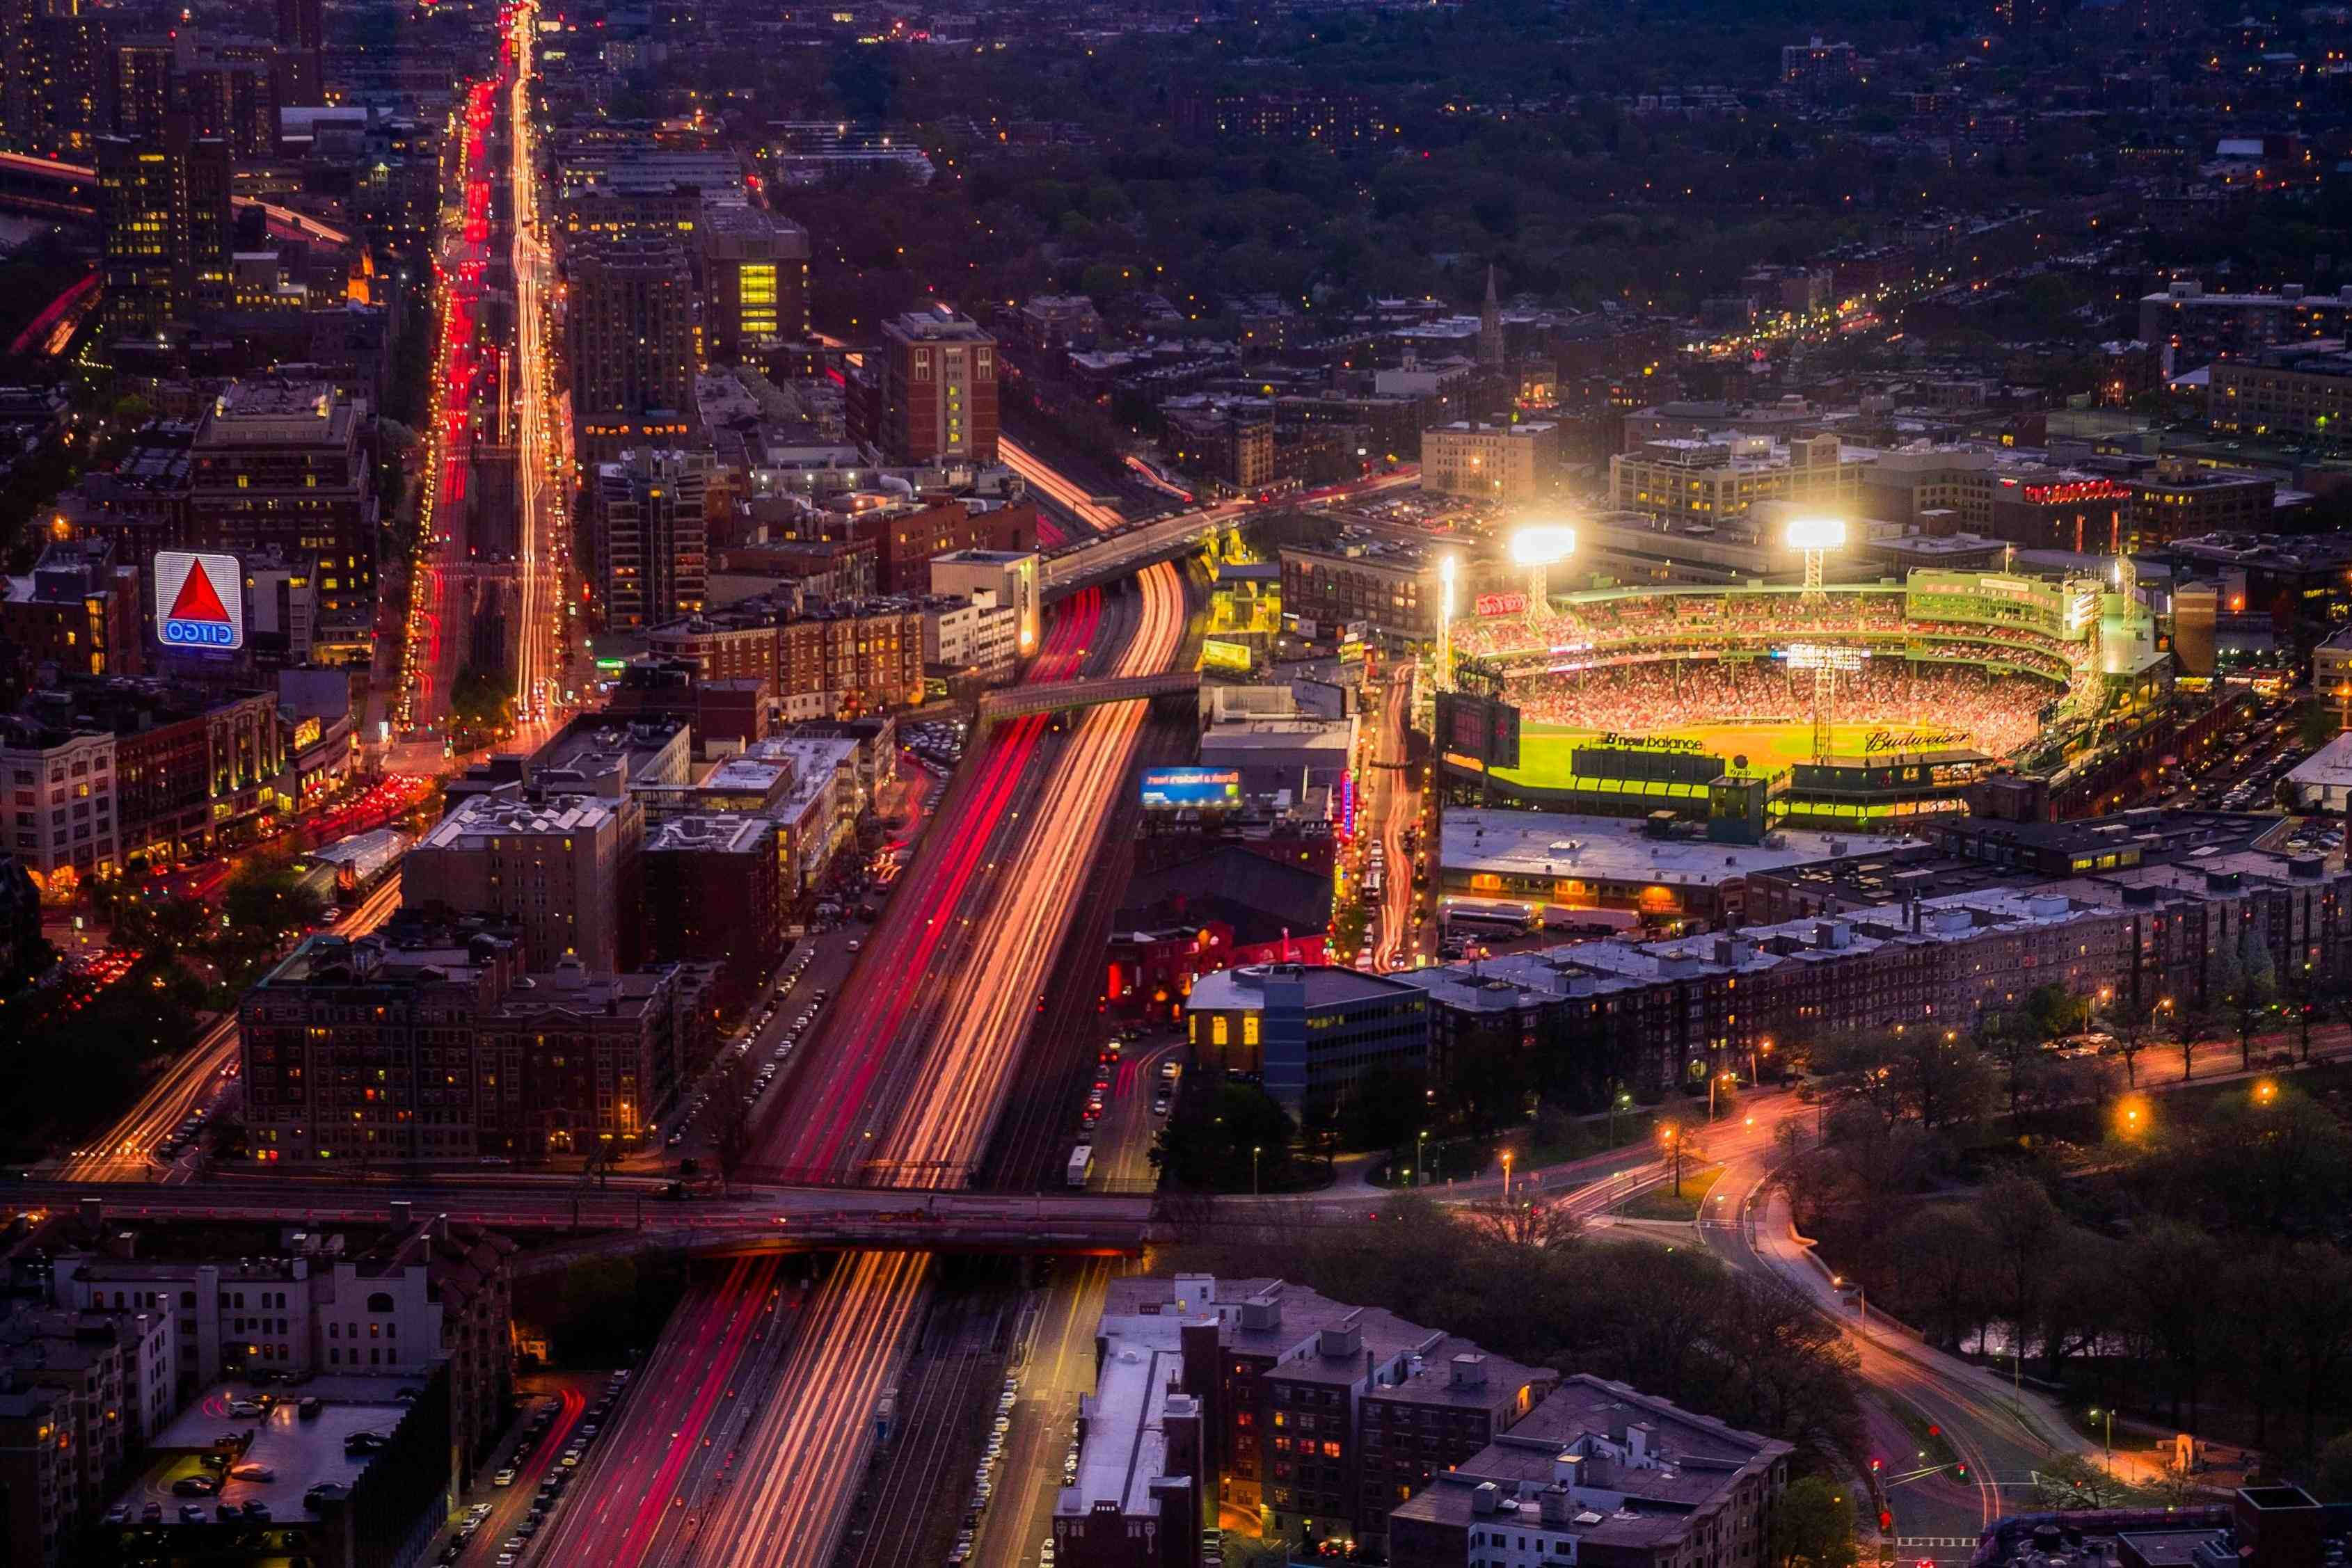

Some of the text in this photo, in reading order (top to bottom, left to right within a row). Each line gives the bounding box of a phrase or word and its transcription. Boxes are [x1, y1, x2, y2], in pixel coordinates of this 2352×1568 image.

[1619, 736, 1645, 746] new
[1648, 735, 1703, 750] balance
[1865, 727, 1970, 752] Budweiser
